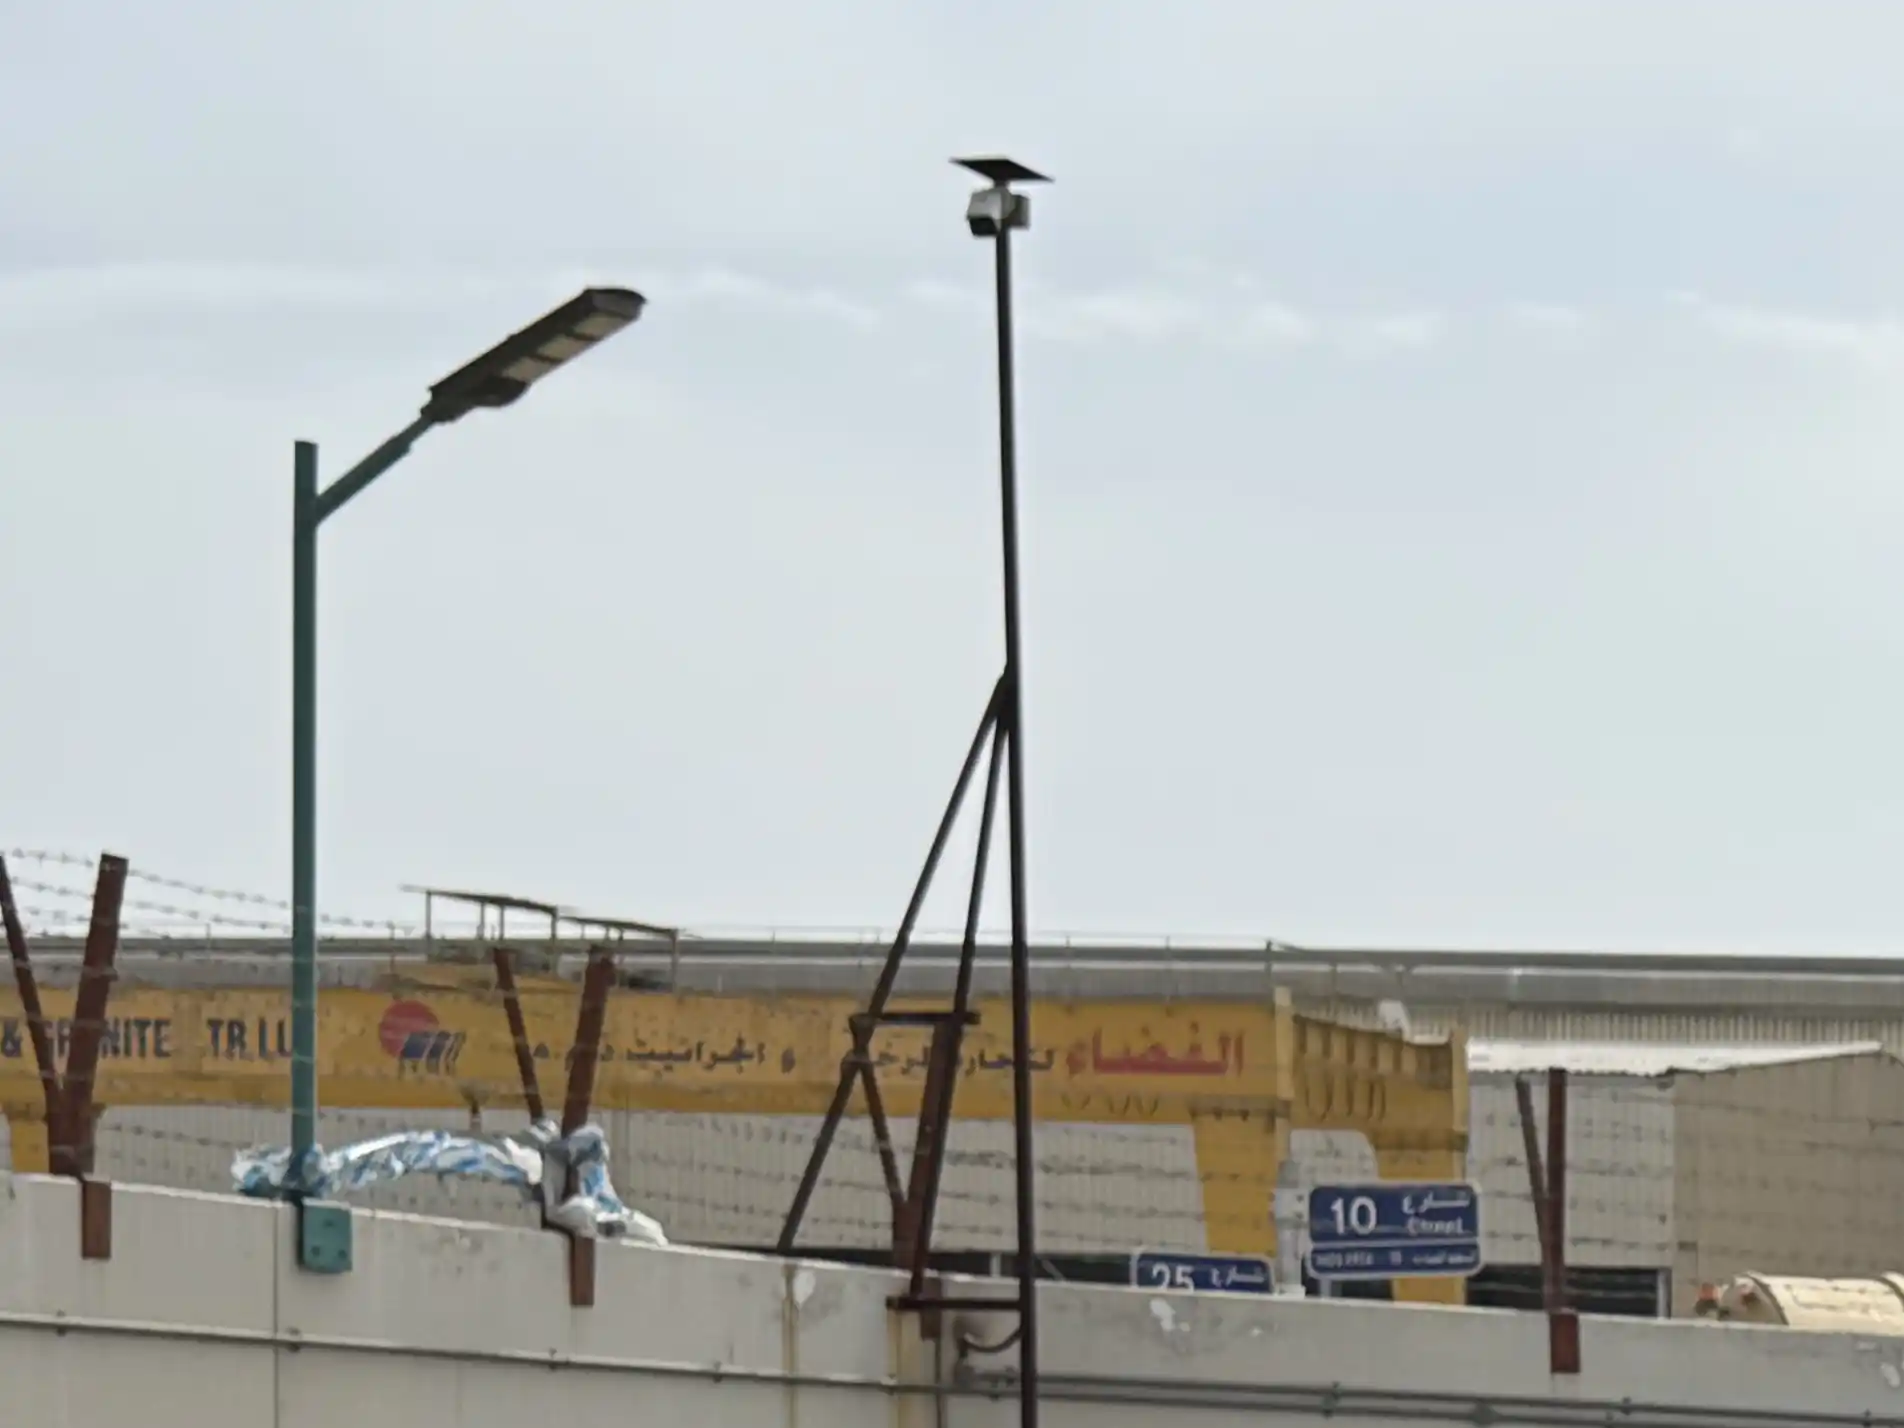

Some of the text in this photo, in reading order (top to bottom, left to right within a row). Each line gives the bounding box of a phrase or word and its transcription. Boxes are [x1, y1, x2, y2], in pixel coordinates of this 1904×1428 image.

[43, 1018, 171, 1058] GRNITE
[1331, 1196, 1377, 1235] 10
[1152, 1262, 1195, 1293] 25
